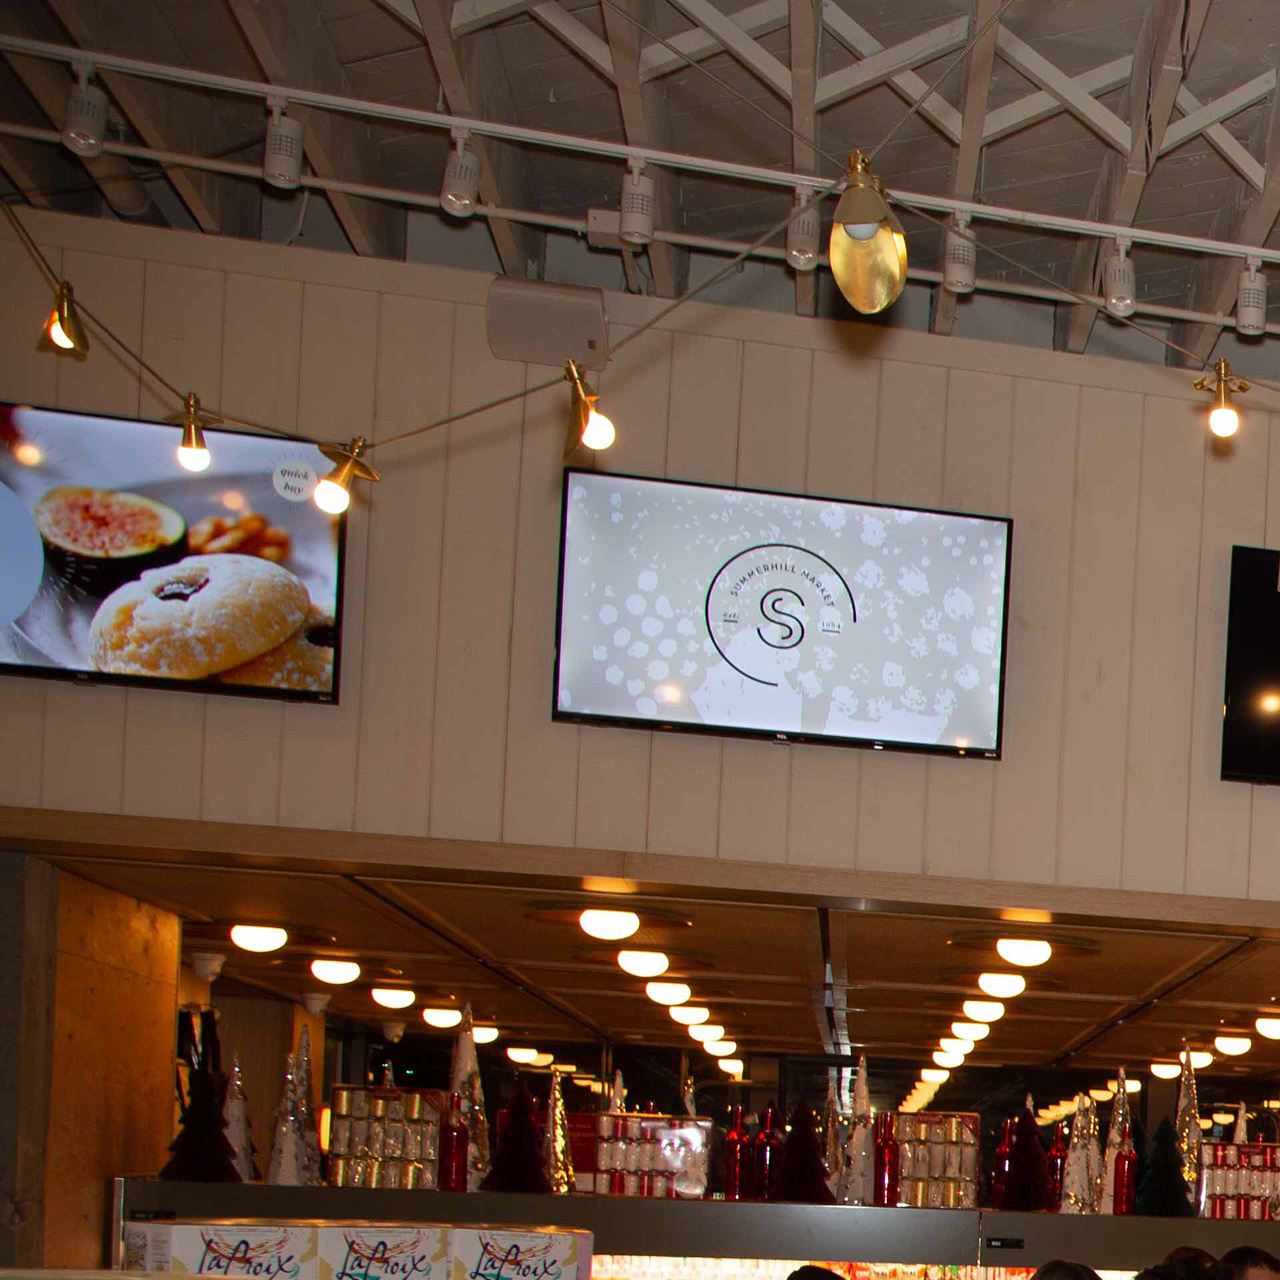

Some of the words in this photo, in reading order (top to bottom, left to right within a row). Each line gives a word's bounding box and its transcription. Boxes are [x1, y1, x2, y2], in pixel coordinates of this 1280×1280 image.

[730, 563, 797, 597] SUMMERHILL
[801, 569, 835, 608] MARKET
[757, 588, 805, 650] S
[198, 1239, 294, 1280] LaCroix
